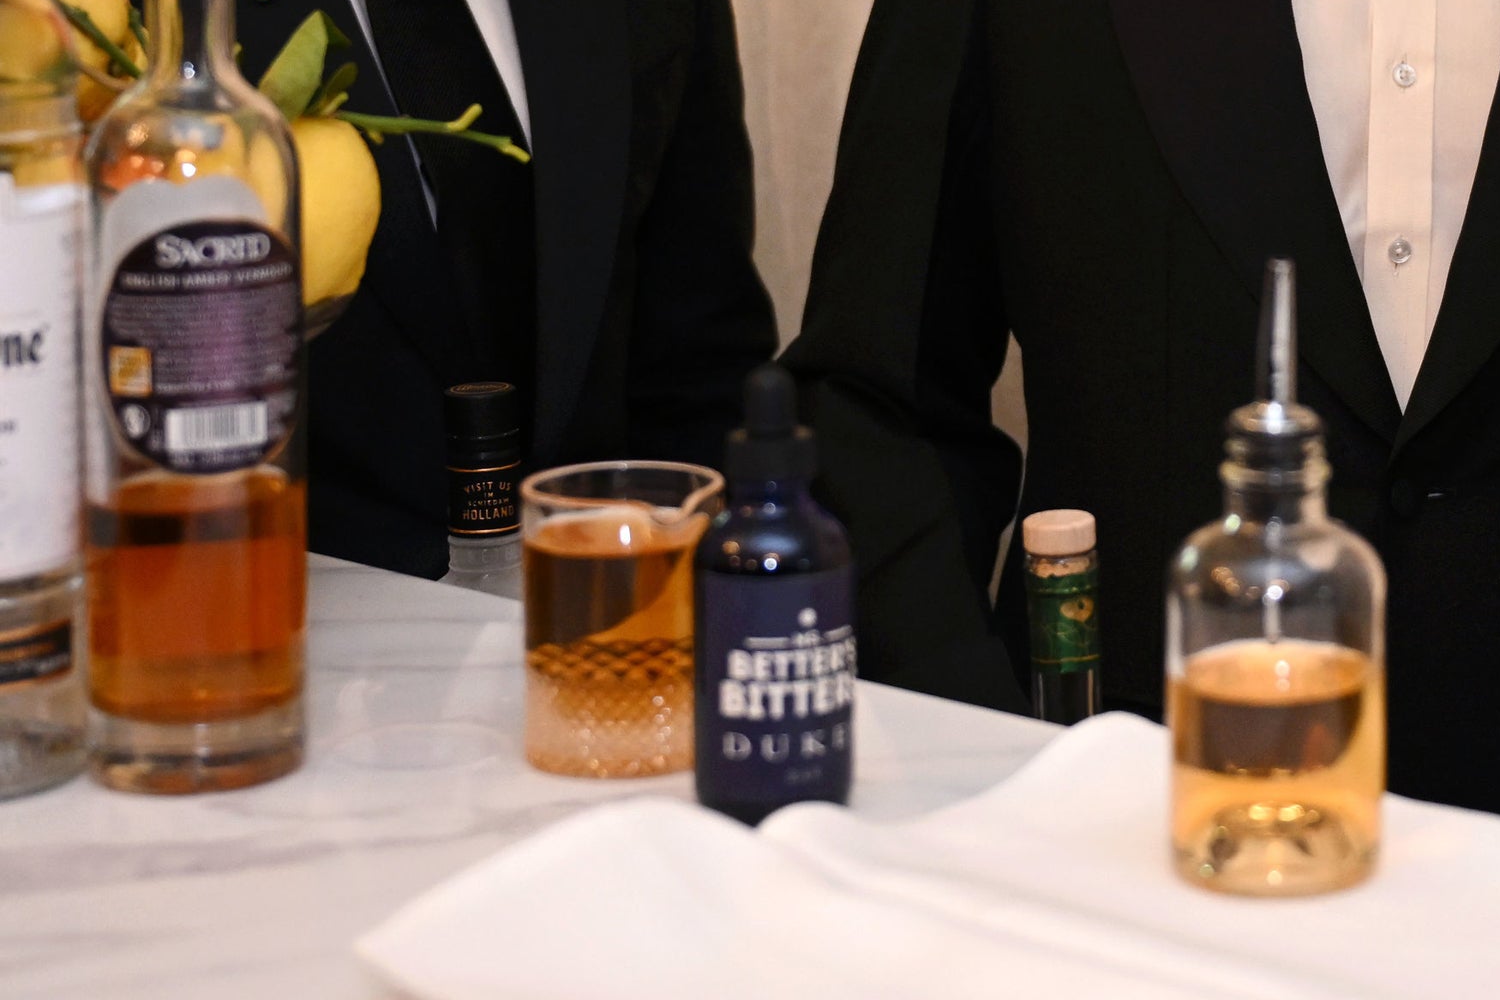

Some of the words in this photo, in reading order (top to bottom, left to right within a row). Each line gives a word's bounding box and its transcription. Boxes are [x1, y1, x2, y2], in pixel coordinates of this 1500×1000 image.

[0, 330, 43, 368] ne
[464, 481, 494, 494] VISIT
[499, 481, 512, 491] US
[463, 504, 514, 521] HOLLAND
